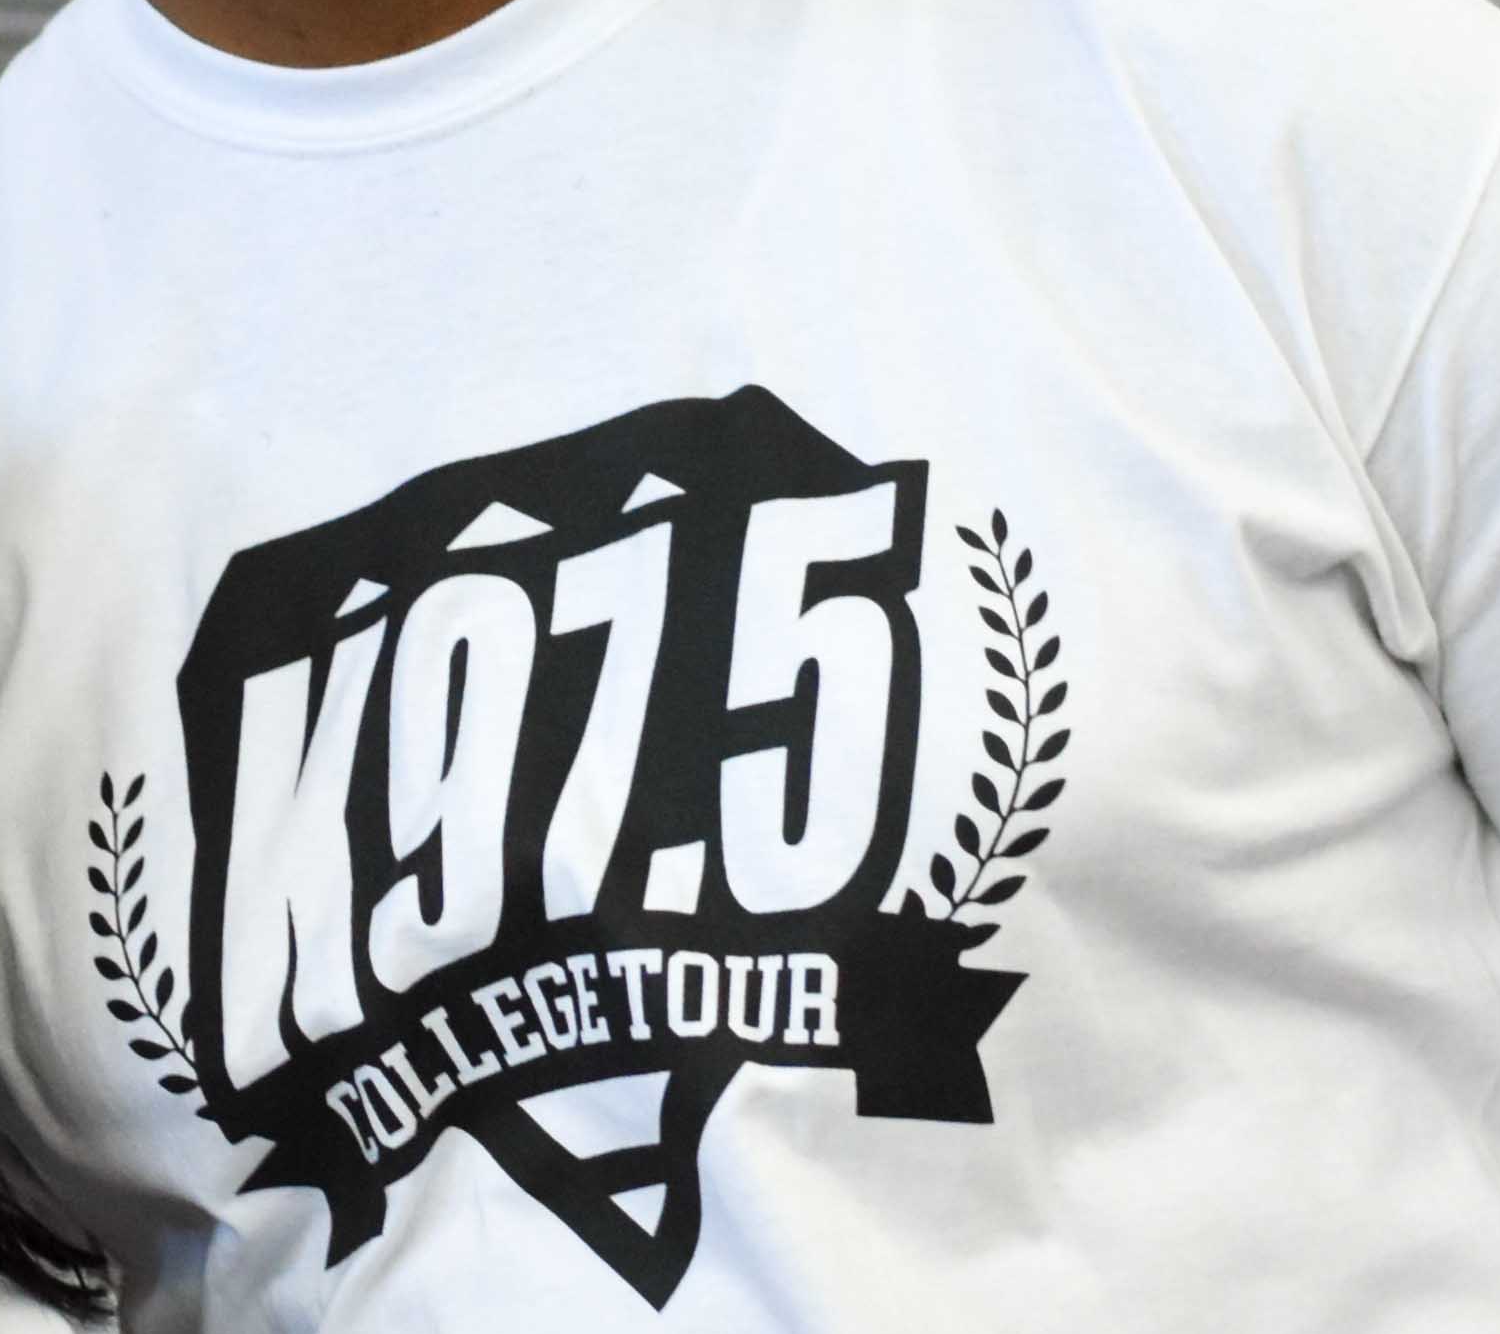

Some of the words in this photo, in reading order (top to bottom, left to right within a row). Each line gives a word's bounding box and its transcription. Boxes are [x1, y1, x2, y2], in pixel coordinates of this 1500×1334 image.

[222, 480, 897, 1091] K97.5
[324, 951, 607, 1164] COLLEGE
[607, 948, 840, 1046] TOUR
